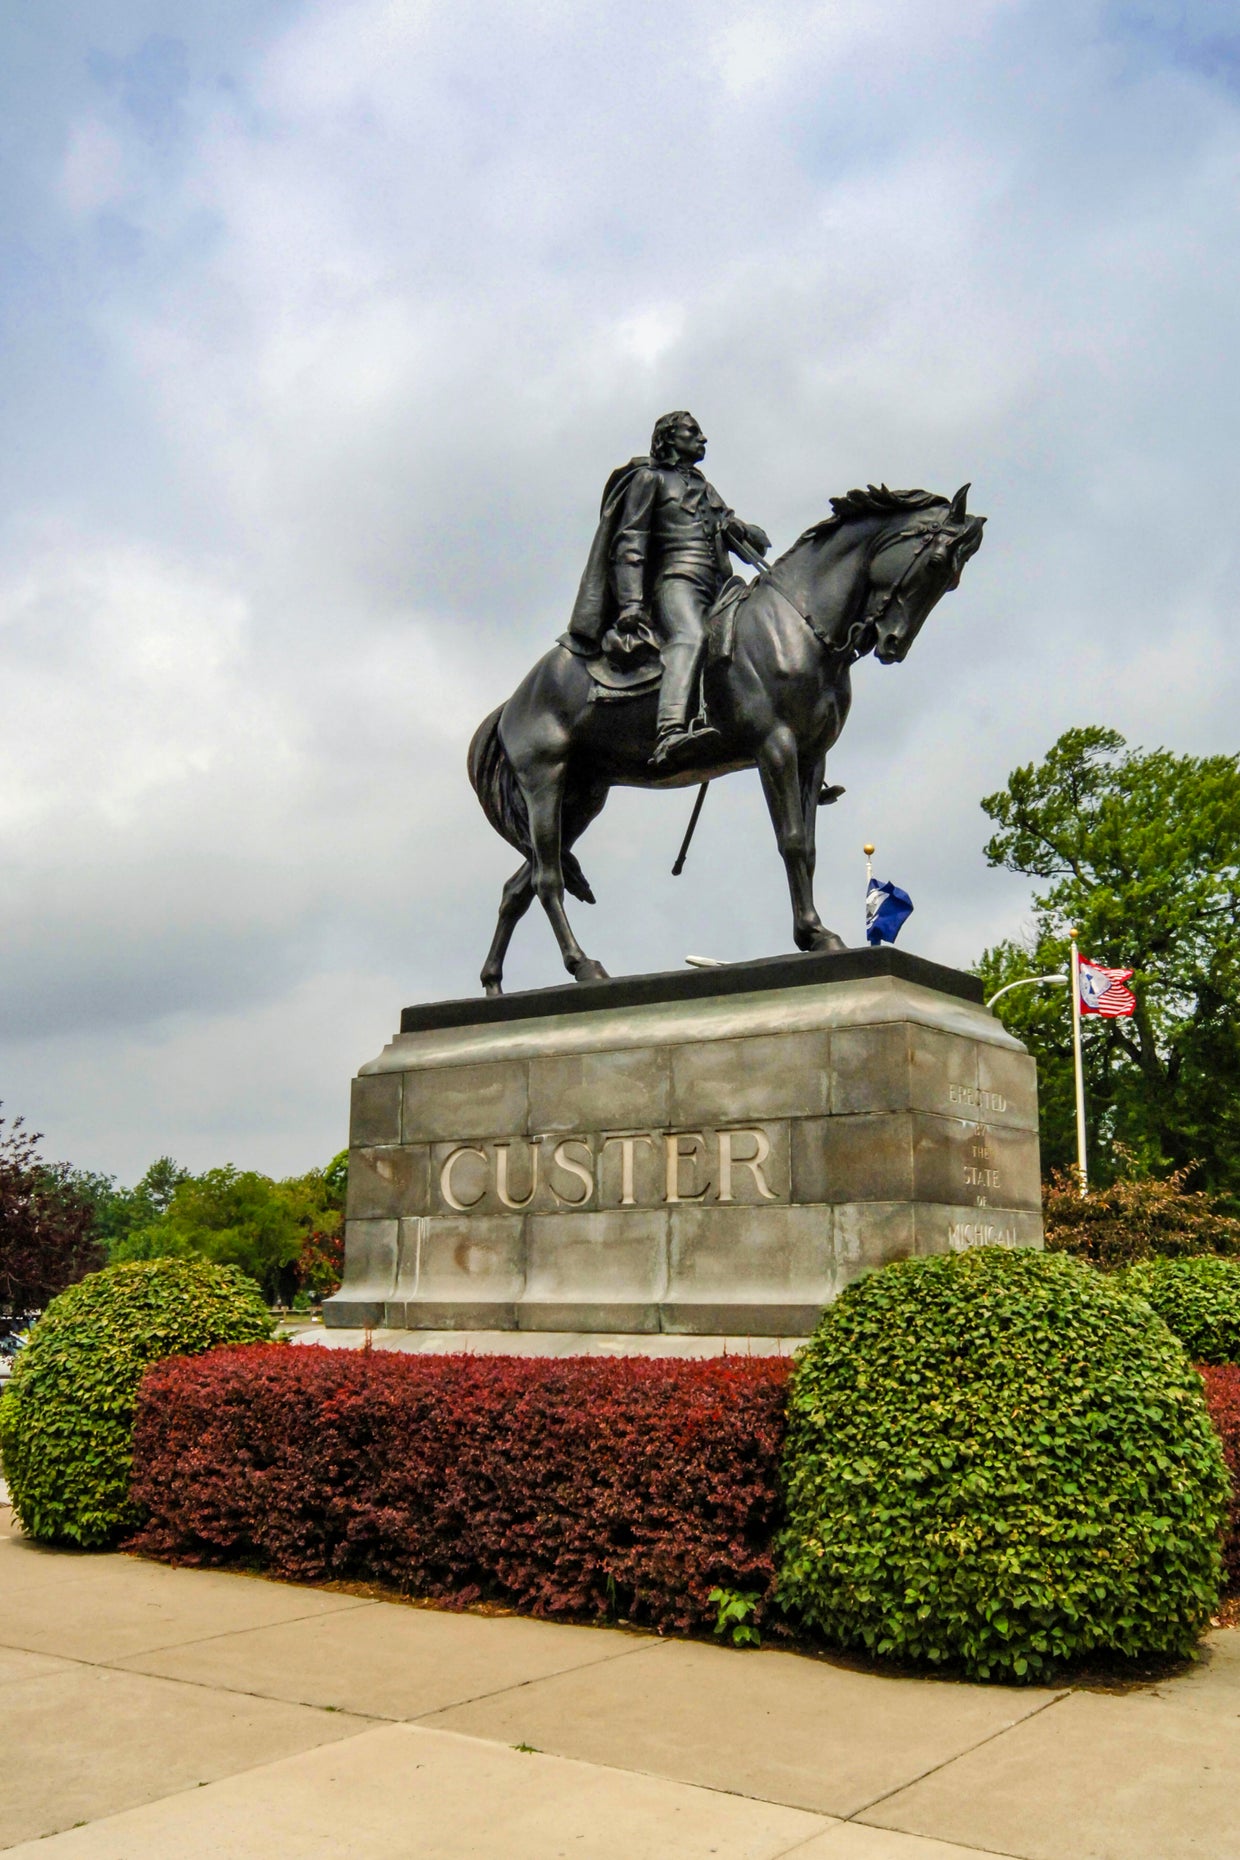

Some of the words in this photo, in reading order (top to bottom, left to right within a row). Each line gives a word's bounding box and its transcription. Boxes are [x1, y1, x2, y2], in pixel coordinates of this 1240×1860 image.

[971, 1146, 990, 1160] THE
[440, 1127, 780, 1212] CUSTER
[963, 1166, 1000, 1188] STATE
[976, 1195, 987, 1207] OF
